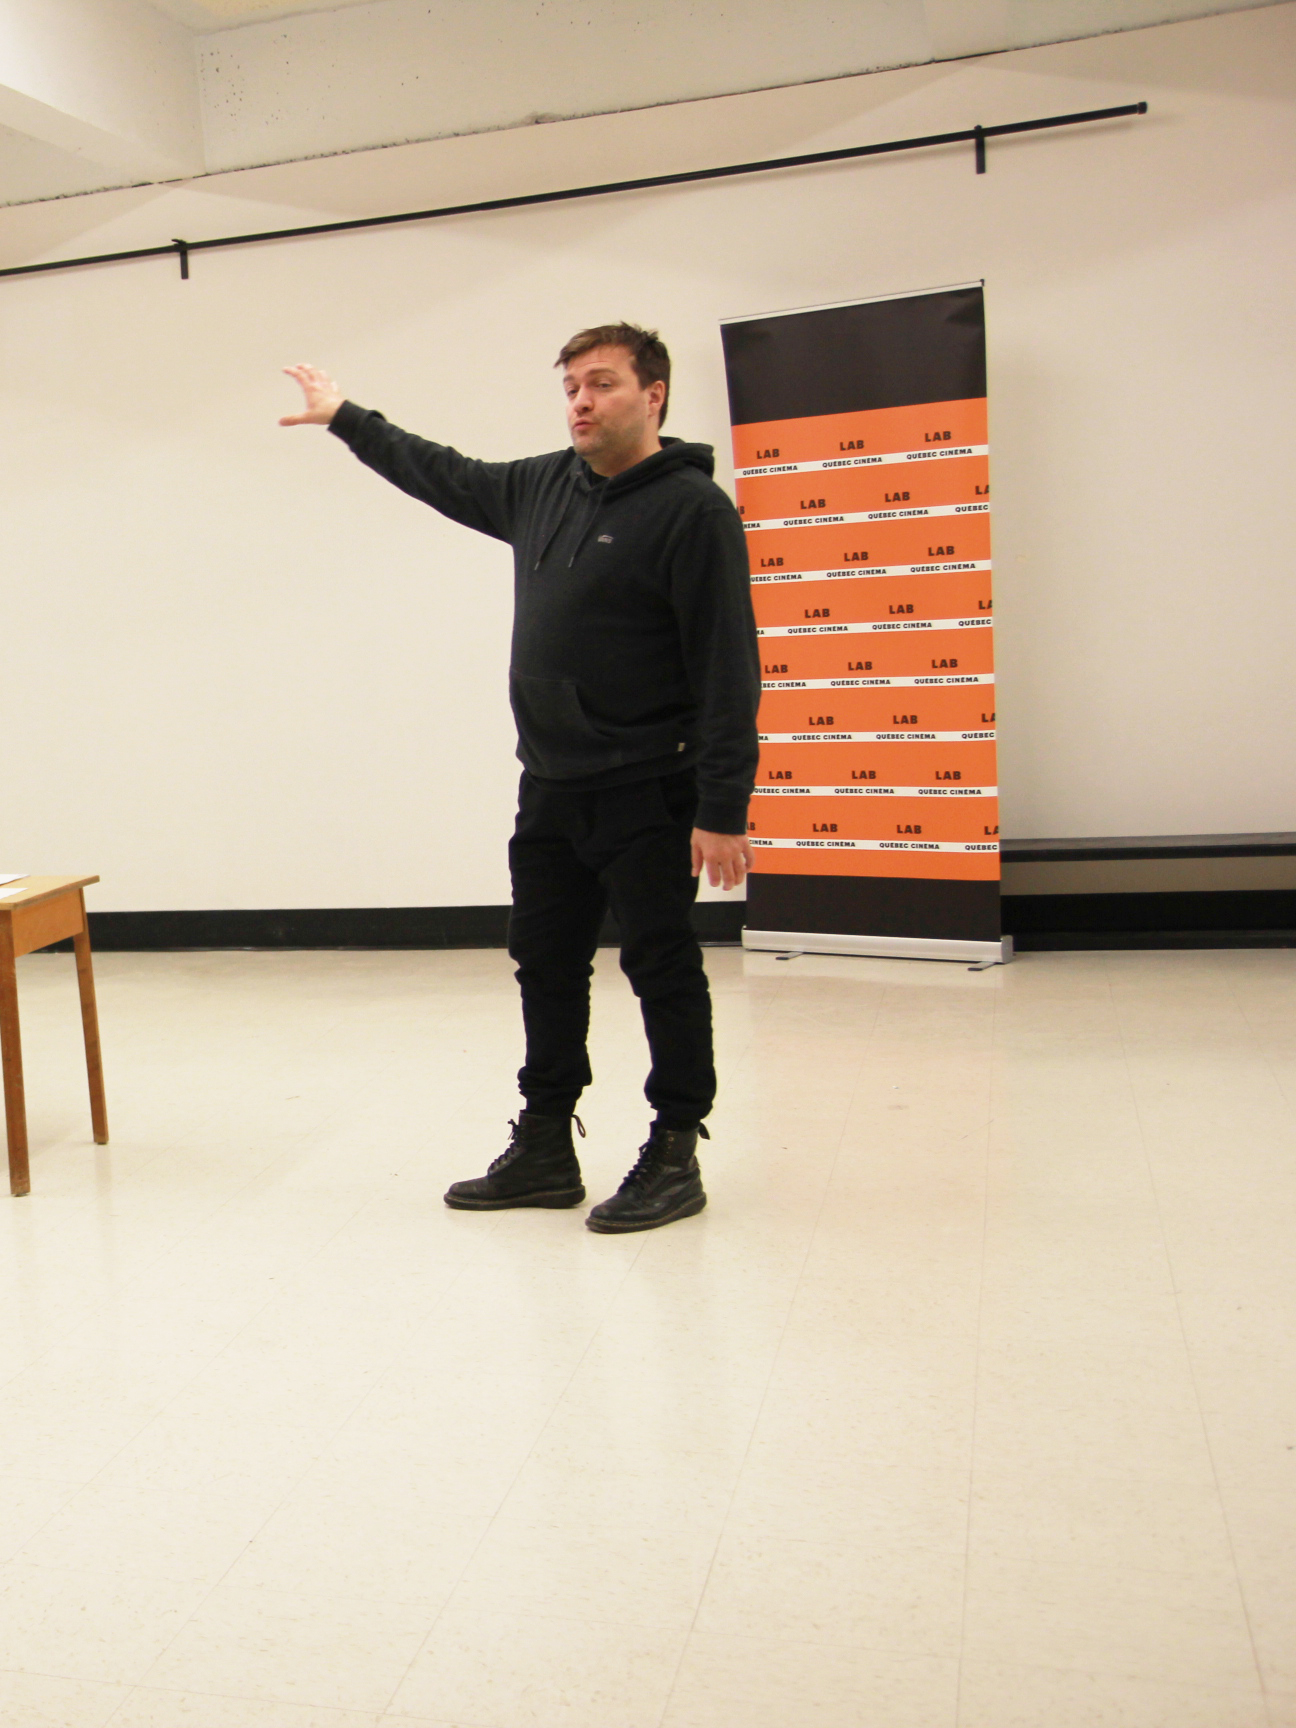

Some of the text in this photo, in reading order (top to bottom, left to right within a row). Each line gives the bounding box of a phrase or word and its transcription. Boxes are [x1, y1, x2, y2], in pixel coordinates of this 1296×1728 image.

[925, 431, 951, 442] LAB
[840, 440, 864, 451] LAB
[757, 448, 780, 459] LAB
[975, 484, 990, 495] LA
[885, 491, 910, 503] LAB
[801, 499, 826, 510] LAB
[928, 545, 955, 556] LAB
[844, 551, 869, 562] LAB
[761, 557, 784, 567] LAB
[889, 604, 914, 614] LAB
[979, 599, 993, 610] LA
[805, 608, 830, 618] LAB
[848, 661, 872, 671] LAB
[932, 658, 958, 669] LAB
[765, 664, 788, 674] LAB
[809, 716, 834, 726] LAB
[893, 715, 918, 724] LAB
[982, 712, 996, 723] LA
[769, 771, 792, 780] LAB
[852, 770, 876, 780] LAB
[936, 771, 961, 780] LAB
[813, 823, 838, 833] LAB
[897, 825, 922, 834] LAB
[985, 825, 999, 835] LA
